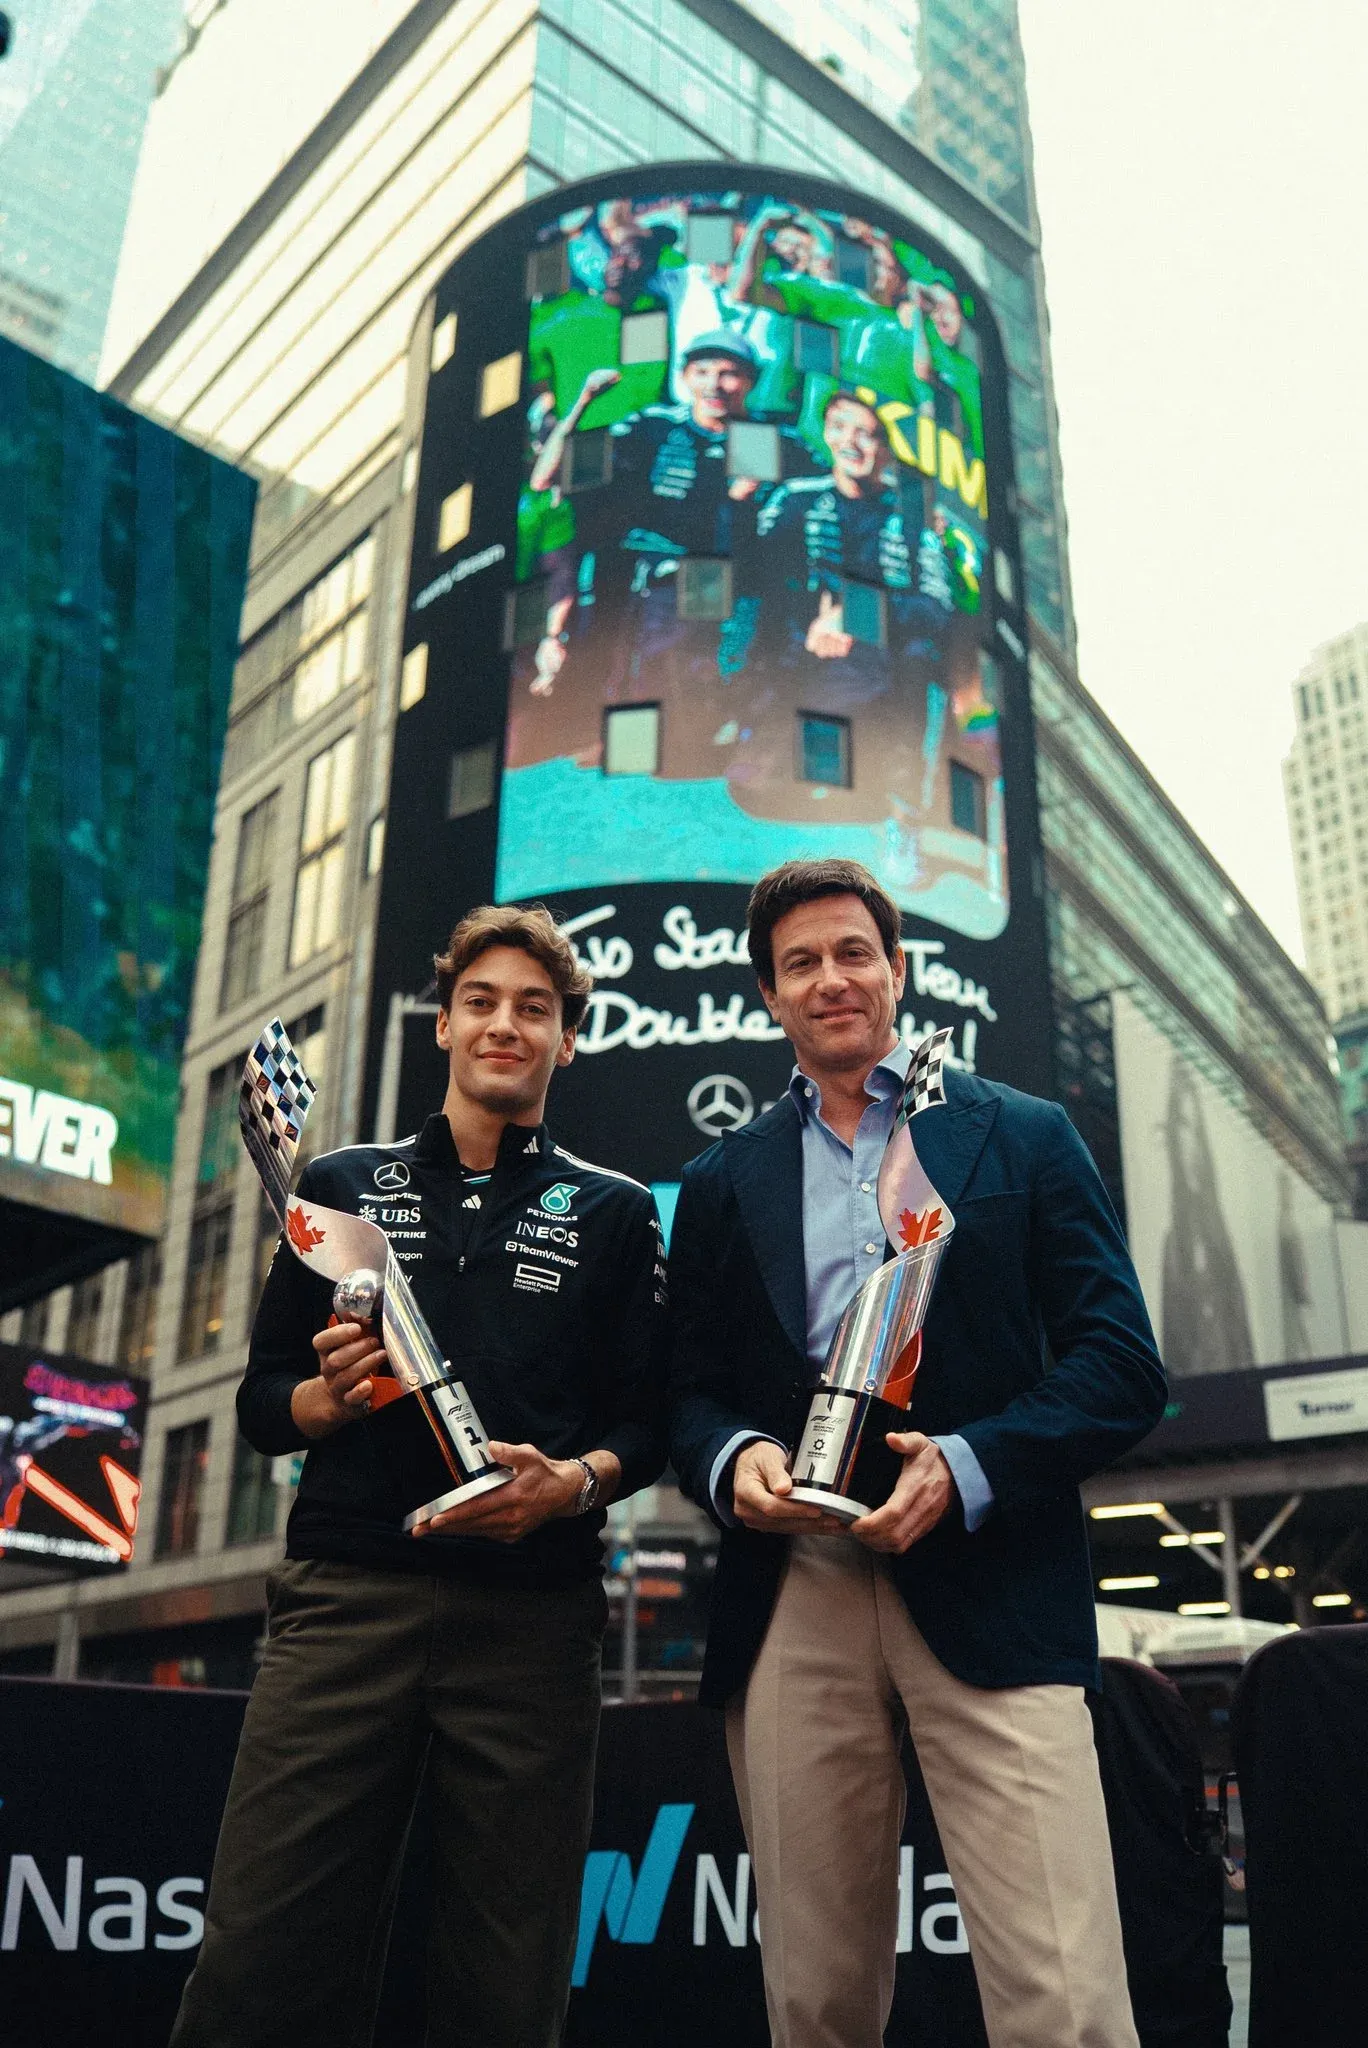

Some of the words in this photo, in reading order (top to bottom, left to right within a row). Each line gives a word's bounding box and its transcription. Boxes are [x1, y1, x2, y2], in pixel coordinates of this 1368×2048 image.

[382, 1192, 422, 1202] AMG
[381, 1207, 421, 1223] UBS
[526, 1207, 579, 1222] PETRONAS
[515, 1220, 579, 1248] INEOS
[394, 1251, 423, 1261] ragon
[518, 1243, 579, 1268] TeamViewer
[463, 1426, 483, 1447] 1
[0, 1854, 205, 1951] Nas
